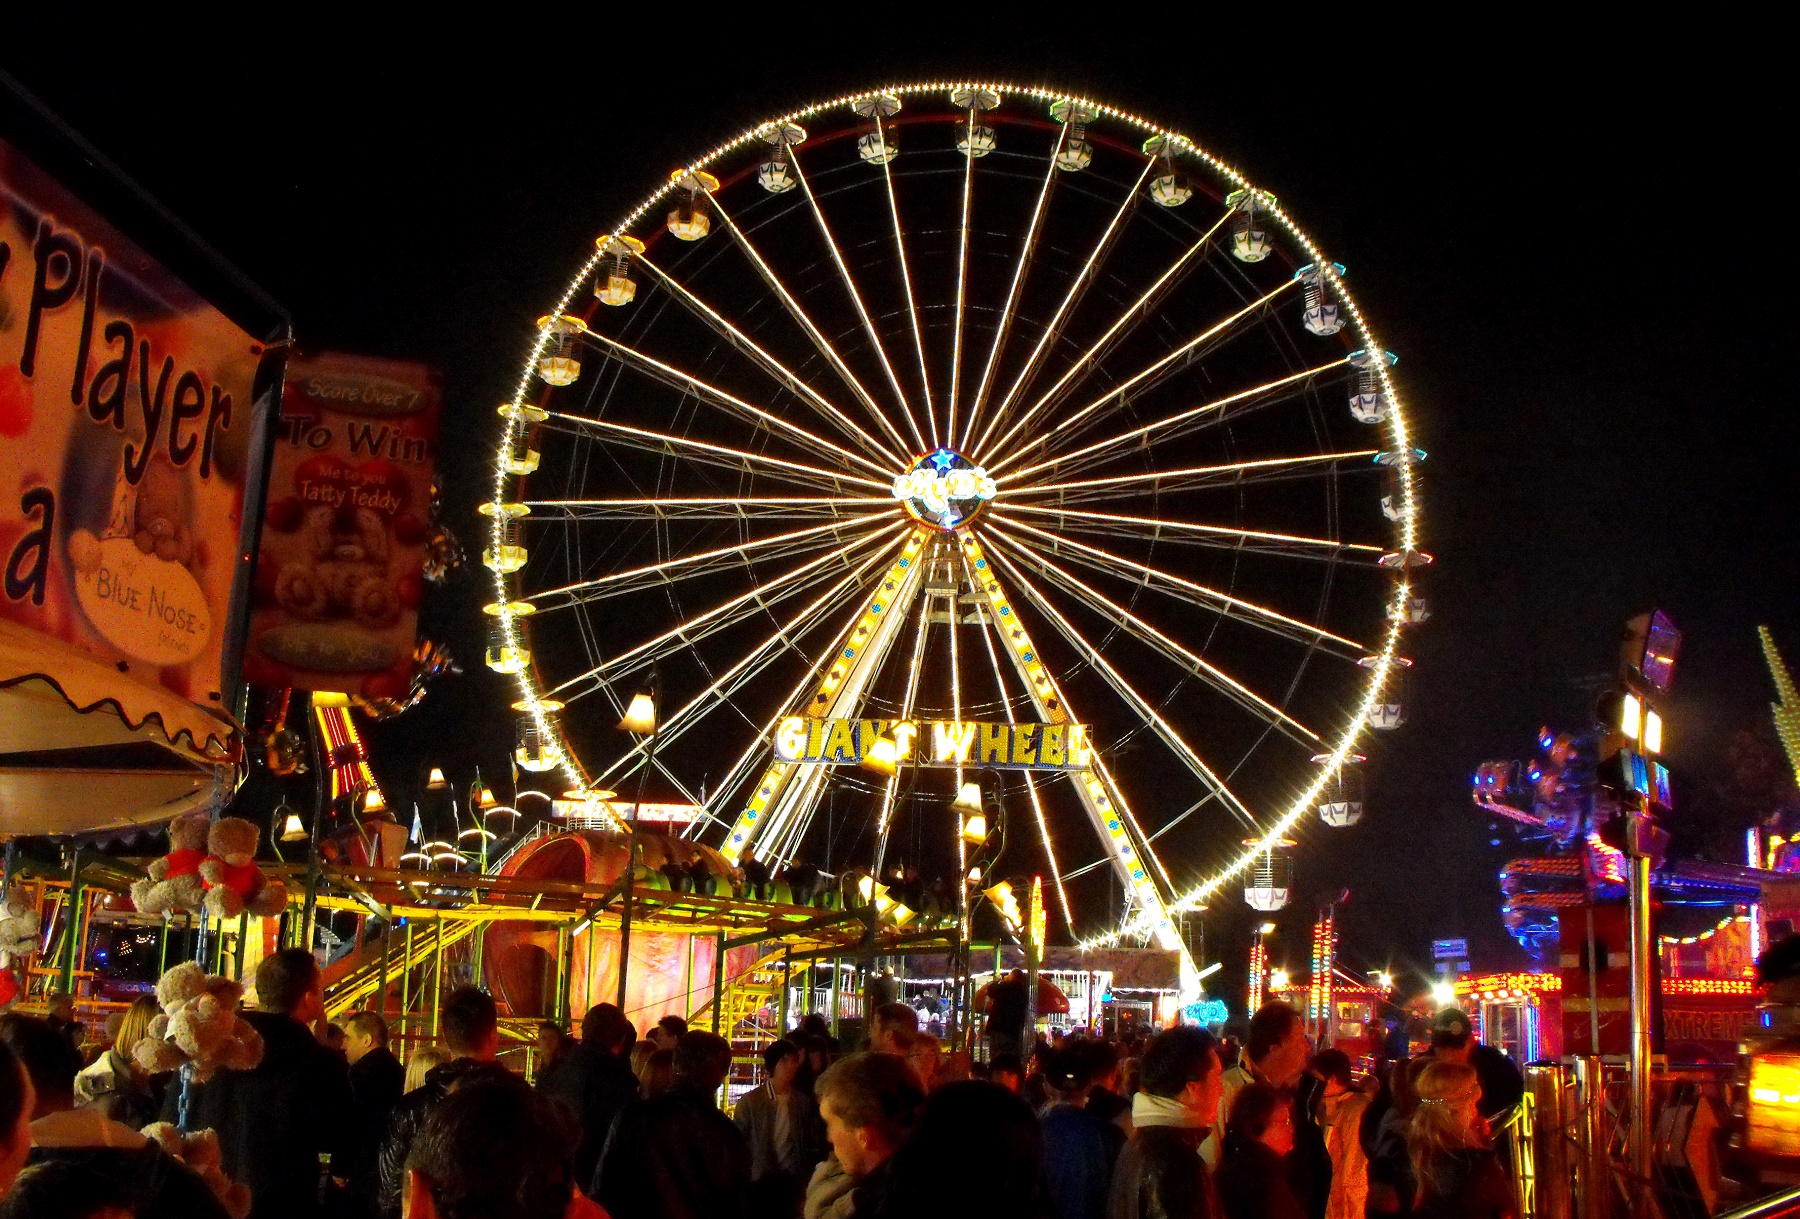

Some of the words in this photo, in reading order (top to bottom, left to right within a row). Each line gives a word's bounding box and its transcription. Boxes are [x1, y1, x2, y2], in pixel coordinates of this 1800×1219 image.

[21, 220, 232, 486] Player
[308, 379, 360, 401] Score
[363, 385, 401, 406] Over
[408, 390, 422, 409] 7
[282, 414, 333, 449] To
[347, 421, 427, 463] Win
[301, 479, 347, 509] Tatty
[350, 485, 401, 515] Teddy
[318, 466, 341, 479] Me
[344, 468, 360, 481] to
[363, 473, 387, 486] you
[775, 716, 918, 761] GIANT
[933, 720, 1092, 767] WHEEL
